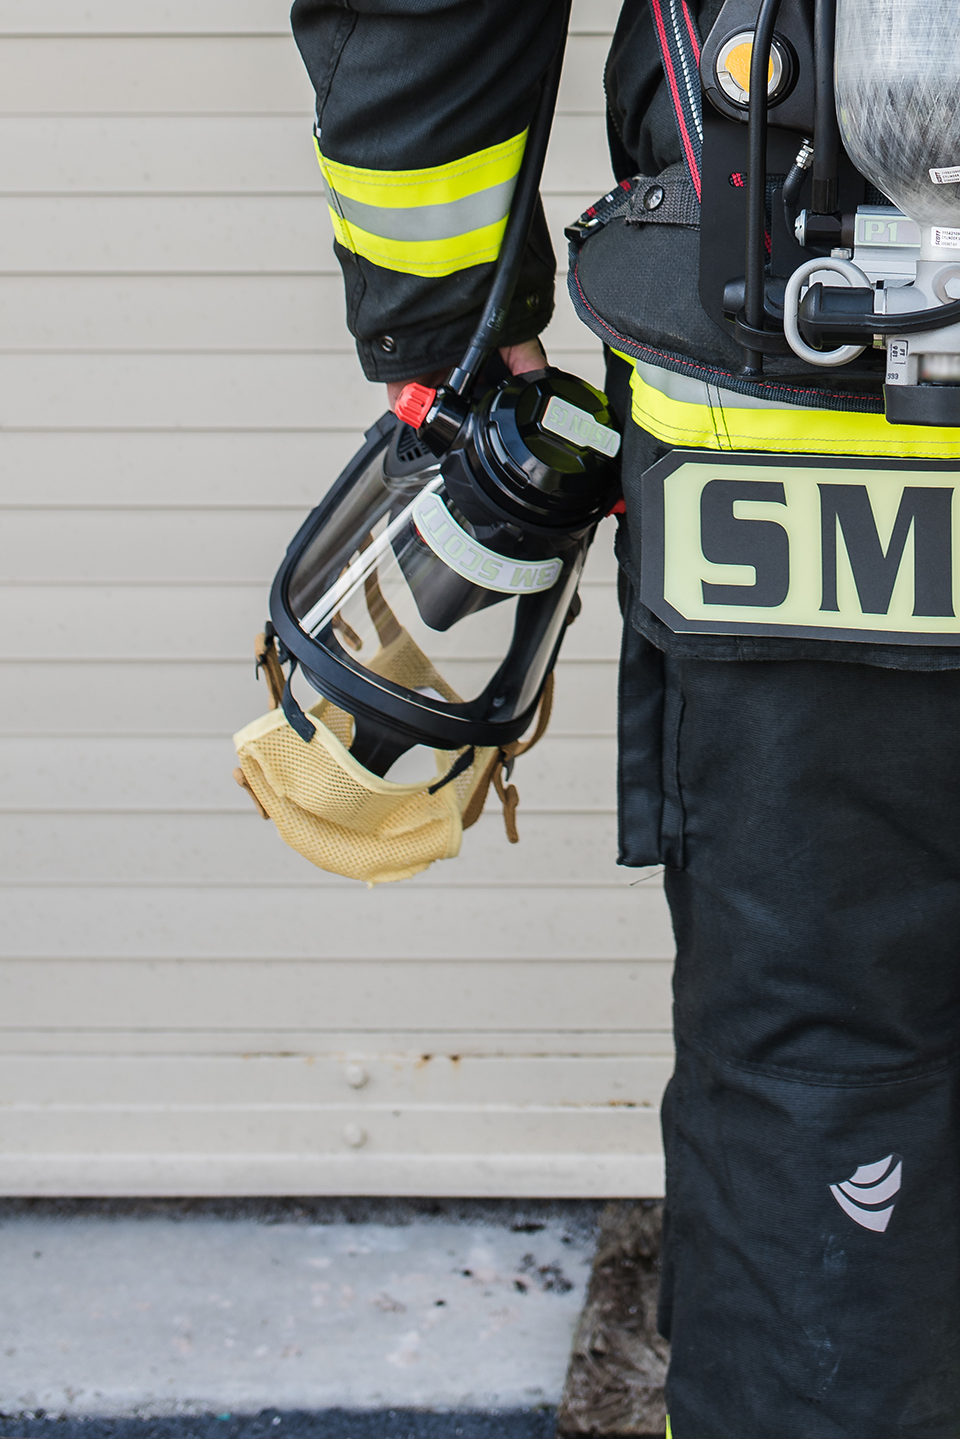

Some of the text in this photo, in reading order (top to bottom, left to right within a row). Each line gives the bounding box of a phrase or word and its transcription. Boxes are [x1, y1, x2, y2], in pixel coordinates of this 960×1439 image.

[864, 220, 898, 242] P1
[549, 404, 616, 453] VISION C5
[418, 505, 556, 589] 3M SCOTT
